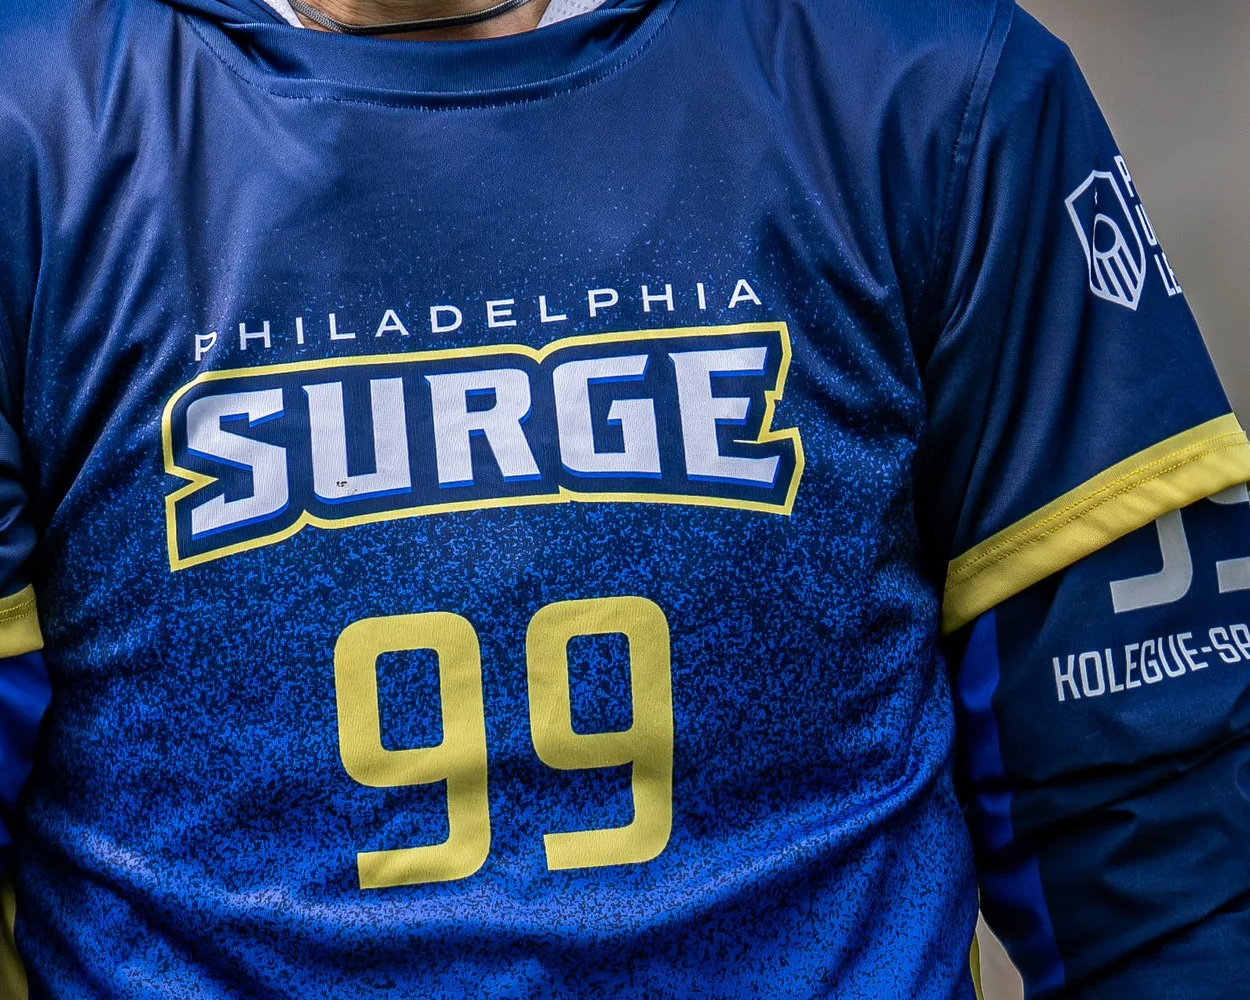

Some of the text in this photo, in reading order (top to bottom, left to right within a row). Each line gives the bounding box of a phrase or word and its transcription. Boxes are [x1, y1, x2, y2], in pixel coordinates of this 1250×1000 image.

[195, 278, 763, 361] PHILADELPHIA
[184, 345, 784, 541] SURGE
[334, 595, 674, 890] 99
